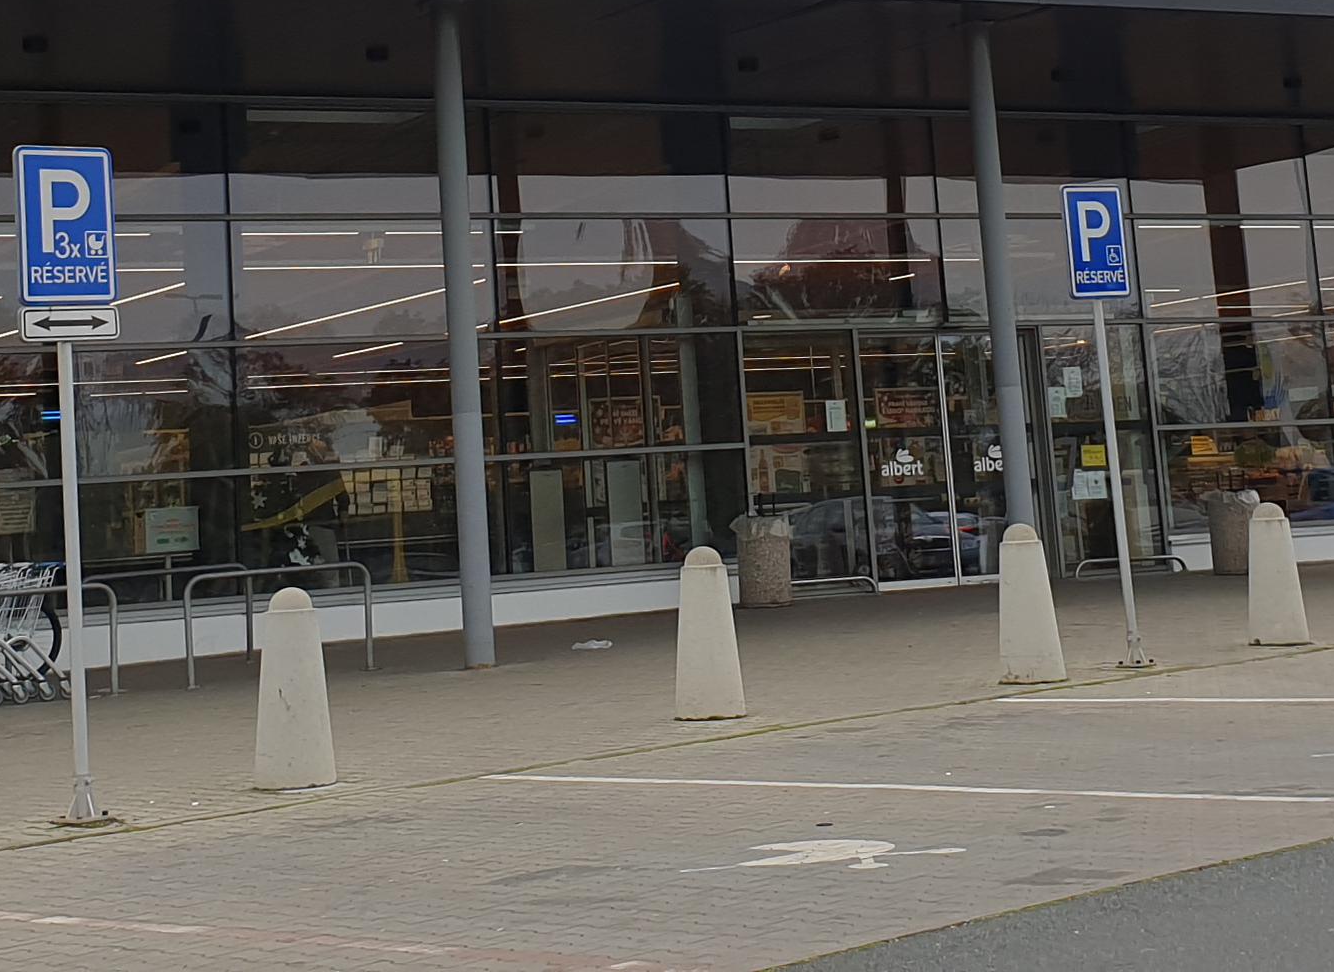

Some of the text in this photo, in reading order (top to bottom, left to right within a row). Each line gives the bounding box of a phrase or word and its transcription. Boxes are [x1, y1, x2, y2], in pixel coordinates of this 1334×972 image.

[39, 169, 90, 253] P
[1077, 201, 1110, 261] P
[54, 231, 81, 258] 3x
[31, 262, 107, 284] RÉSERVÉ
[1076, 267, 1125, 284] RÉSERVÉ
[881, 459, 924, 476] albert
